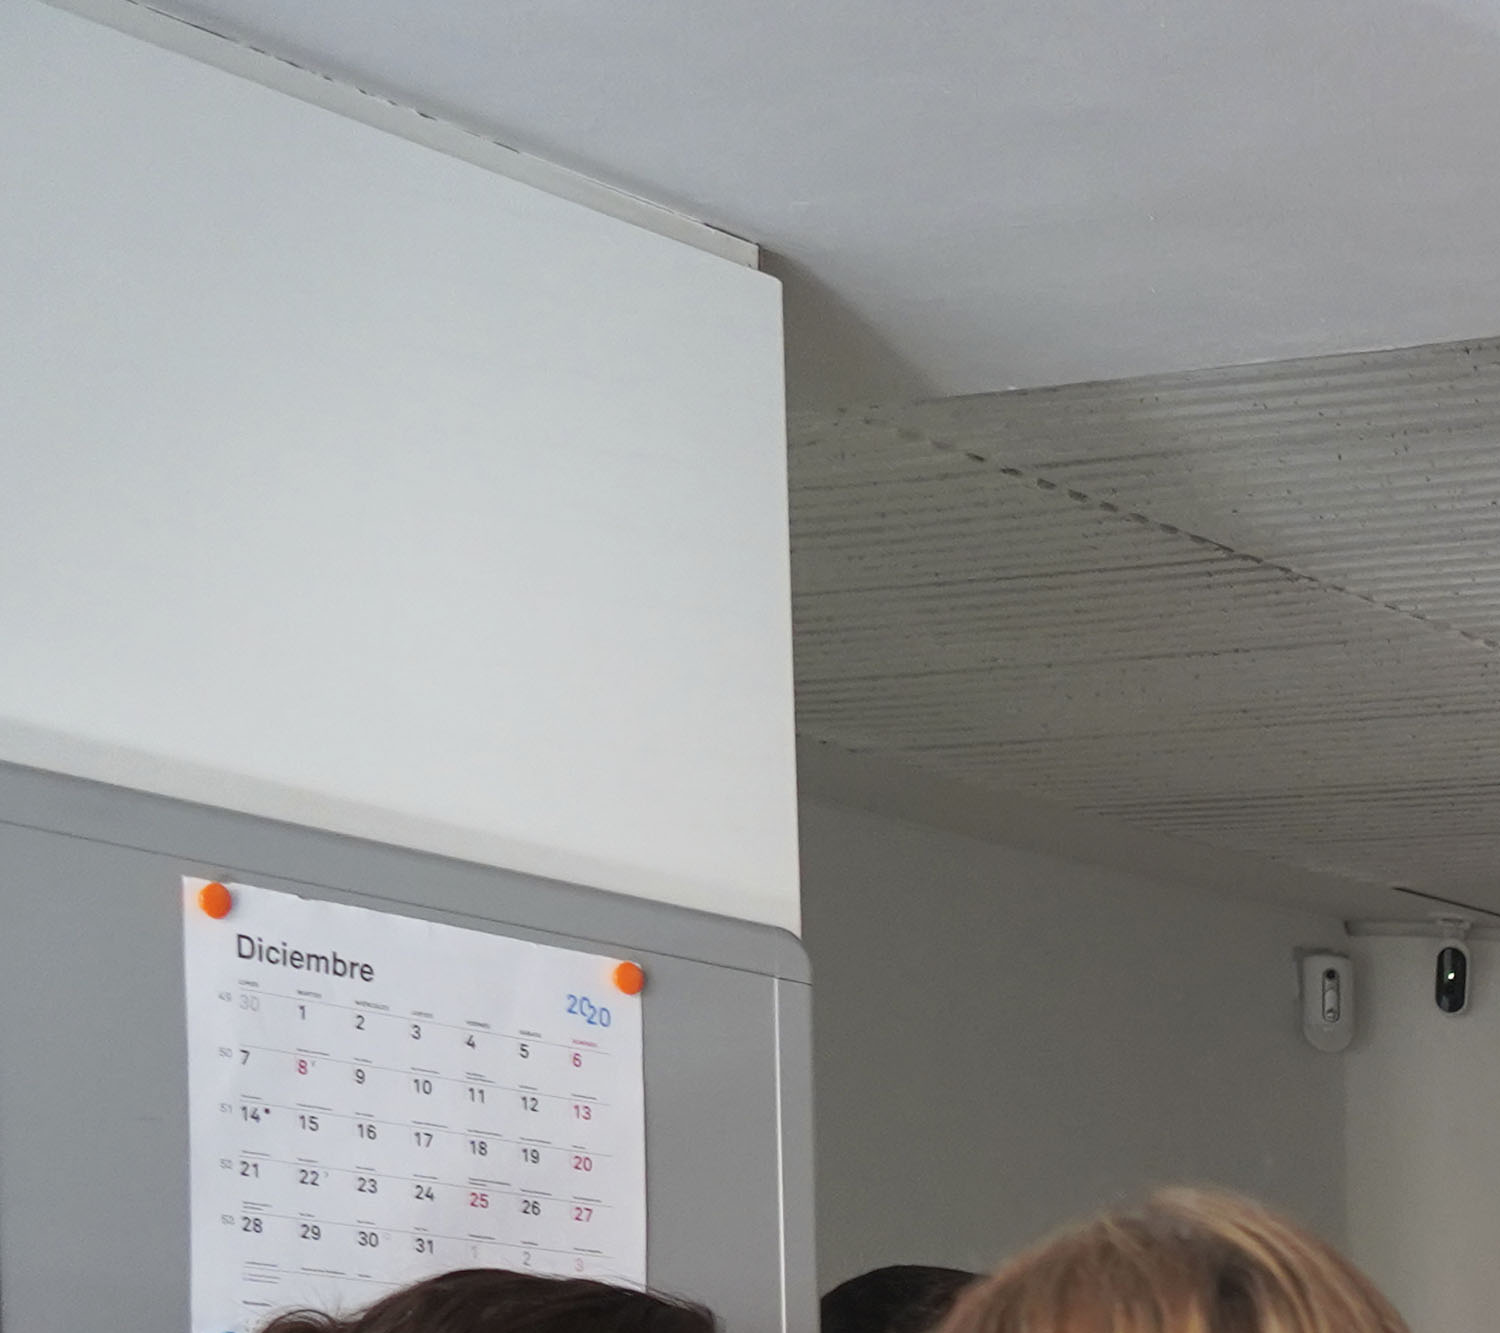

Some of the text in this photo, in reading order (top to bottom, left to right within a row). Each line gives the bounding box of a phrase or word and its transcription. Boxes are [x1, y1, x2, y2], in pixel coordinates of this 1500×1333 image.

[236, 933, 375, 982] Diciembre
[239, 993, 260, 1012] 30
[299, 1005, 306, 1020] 1
[355, 1015, 365, 1030] 2
[411, 1024, 421, 1040] 3
[465, 1035, 476, 1049] 4
[519, 1043, 529, 1059] 5
[572, 1053, 582, 1068] 6
[566, 993, 611, 1028] 2020
[240, 1049, 250, 1065] 7
[298, 1059, 308, 1075] 8
[355, 1069, 365, 1084] 9
[413, 1078, 433, 1095] 10
[468, 1087, 485, 1103] 11
[521, 1096, 539, 1112] 12
[573, 1105, 592, 1120] 13
[241, 1106, 261, 1123] 14
[299, 1115, 319, 1132] 15
[357, 1123, 377, 1140] 16
[414, 1132, 433, 1148] 17
[469, 1140, 488, 1156] 18
[522, 1148, 540, 1164] 19
[572, 1156, 593, 1171] 20
[240, 1161, 259, 1178] 21
[299, 1169, 320, 1186] 22
[357, 1177, 378, 1194] 23
[414, 1185, 434, 1201] 24
[469, 1192, 489, 1209] 25
[521, 1200, 541, 1216] 26
[573, 1207, 593, 1222] 27
[242, 1216, 263, 1233] 28
[301, 1224, 322, 1241] 29
[358, 1231, 379, 1248] 30
[415, 1238, 434, 1255] 31
[522, 1251, 531, 1266] 2
